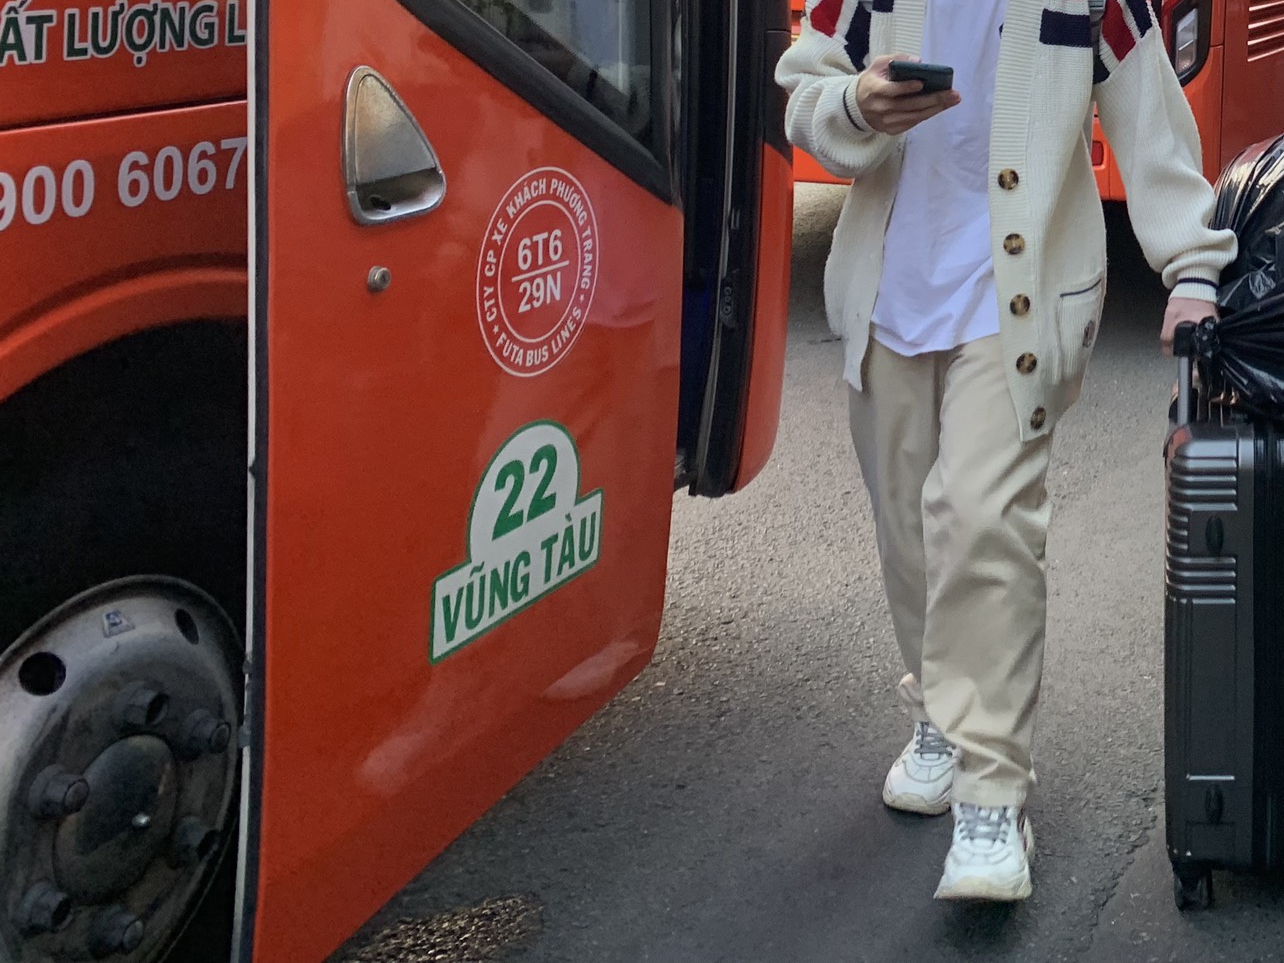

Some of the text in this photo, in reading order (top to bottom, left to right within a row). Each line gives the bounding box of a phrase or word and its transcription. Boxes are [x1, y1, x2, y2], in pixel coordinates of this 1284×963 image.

[117, 137, 247, 208] 6067
[483, 178, 593, 322] CTY CP XE KHÁCH PHƯƠNG TRANG
[517, 229, 562, 271] 6T6
[518, 271, 561, 314] 29N
[495, 306, 582, 367] FUTA BUS LINES
[491, 444, 557, 541] 22
[441, 514, 598, 642] VŨNG TÀU
